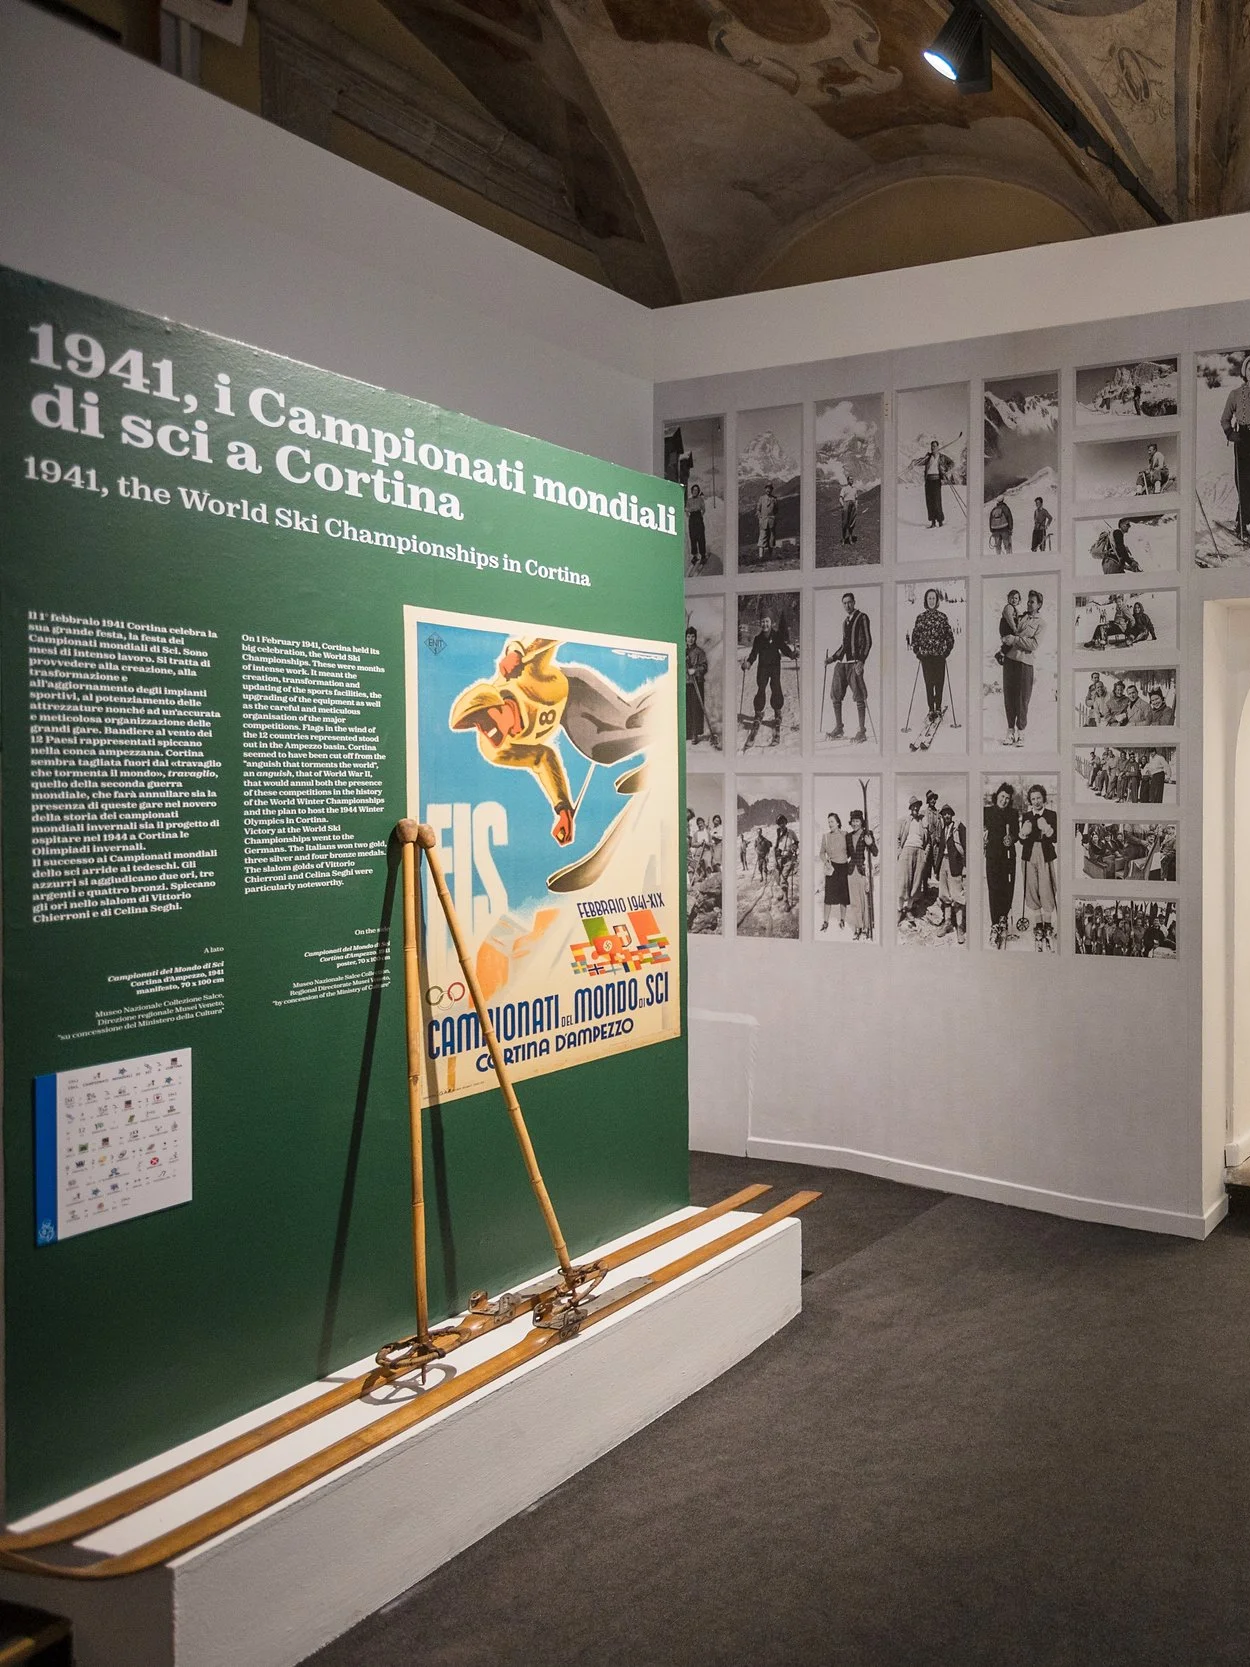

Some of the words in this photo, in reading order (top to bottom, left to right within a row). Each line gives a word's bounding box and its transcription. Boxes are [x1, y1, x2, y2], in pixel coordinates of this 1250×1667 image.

[29, 323, 198, 413] 1941,
[214, 373, 235, 416] i
[249, 388, 526, 494] Campionati
[533, 475, 677, 535] mondiali
[31, 384, 104, 438] di
[121, 415, 213, 463] sci
[227, 441, 262, 474] a
[276, 446, 464, 520] Cortina
[24, 456, 108, 497] 1941,
[118, 476, 171, 504] the
[178, 487, 269, 524] World
[275, 508, 319, 534] Ski
[325, 518, 499, 570] Championships
[502, 554, 522, 573] in
[525, 559, 591, 586] Cortina
[29, 634, 97, 648] Campionati
[100, 642, 148, 652] mondiali
[150, 644, 160, 653] di
[162, 645, 181, 655] Sci.
[183, 647, 208, 657] Sono
[29, 659, 96, 670] provvedere
[99, 662, 119, 671] alla
[121, 665, 176, 677] creazione,
[178, 667, 197, 676] alla
[242, 653, 311, 668] Championships.
[312, 659, 336, 668] These
[357, 664, 385, 672] months
[30, 668, 120, 681] trasformazione
[242, 674, 281, 684] creation,
[282, 675, 344, 687] transformation
[30, 679, 134, 693] all'aggiornamento
[136, 685, 162, 697] degli
[164, 686, 207, 699] impianti
[30, 702, 103, 713] attrezzature
[106, 706, 145, 715] nonché
[147, 706, 160, 715] ad
[162, 707, 221, 718] un'accurata
[254, 702, 269, 710] the
[270, 704, 300, 712] careful
[301, 705, 317, 713] and
[318, 706, 360, 715] meticulous
[40, 713, 102, 723] meticolosa
[104, 716, 185, 727] organizzazione
[187, 718, 211, 727] delle
[243, 713, 297, 722] organisation
[299, 714, 308, 722] of
[308, 714, 321, 722] the
[323, 717, 346, 725] major
[31, 735, 43, 744] 12
[46, 735, 77, 744] Paesi
[80, 737, 156, 748] rappresentati
[158, 738, 202, 749] spiccano
[244, 817, 284, 827] Olympics
[286, 816, 294, 824] in
[296, 816, 328, 824] Cortina.
[32, 844, 90, 857] Olimpiadi
[93, 842, 146, 853] invernali.
[245, 882, 296, 895] particularly
[297, 878, 344, 888] noteworthy.
[577, 898, 626, 918] FEBBRAIO
[628, 892, 665, 913] 1941-XIX
[210, 945, 224, 953] lato
[108, 969, 158, 982] Campionati
[160, 967, 173, 976] del
[174, 964, 202, 974] Mondo
[212, 960, 224, 968] Sci
[131, 978, 162, 987] Cortina
[163, 972, 207, 983] d'Ampezzo,
[208, 968, 224, 977] 1941
[136, 983, 180, 995] manifesto,
[198, 978, 211, 986] 100
[561, 1015, 573, 1027] DEL
[574, 977, 638, 1024] MONDO
[639, 998, 646, 1008] DI
[646, 971, 669, 1006] SCI
[555, 1018, 634, 1052] D'AMPEZZO
